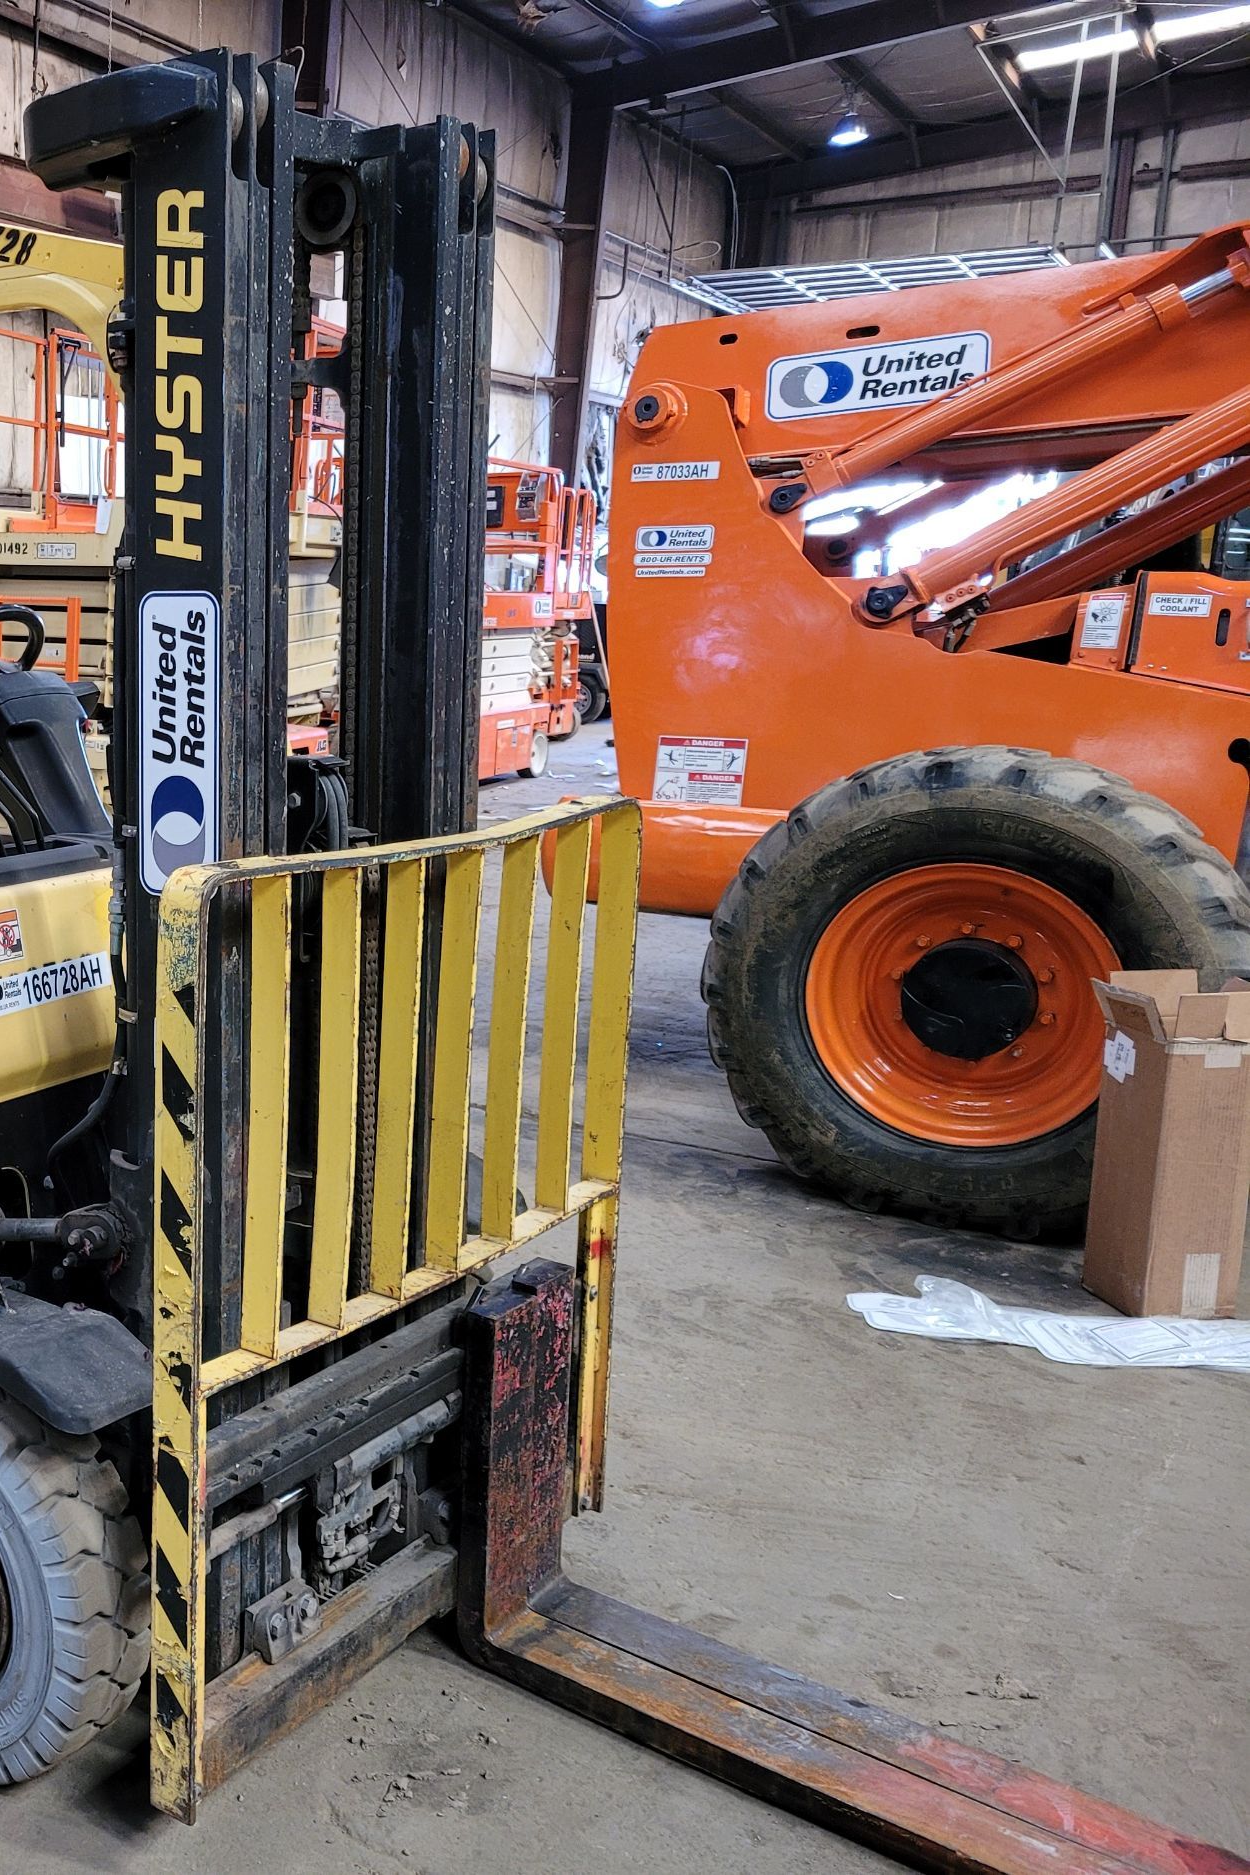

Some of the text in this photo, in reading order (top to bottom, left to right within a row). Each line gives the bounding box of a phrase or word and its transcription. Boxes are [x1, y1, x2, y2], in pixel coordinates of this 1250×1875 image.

[862, 344, 968, 377] United
[155, 188, 206, 562] HYSTER
[859, 368, 975, 400] Rentals
[656, 464, 710, 480] 87033AH
[669, 529, 707, 539] United
[668, 538, 708, 548] Rentals
[640, 555, 706, 563] 800-UR-RENTS
[637, 568, 704, 577] UnitedRentals.com
[1155, 596, 1184, 604] CHECK
[1190, 598, 1208, 606] FILL
[1160, 605, 1200, 613] COOLANT
[152, 622, 177, 765] United
[180, 608, 207, 769] Rentals
[3, 978, 19, 990] United
[23, 957, 103, 1005] 166728AH
